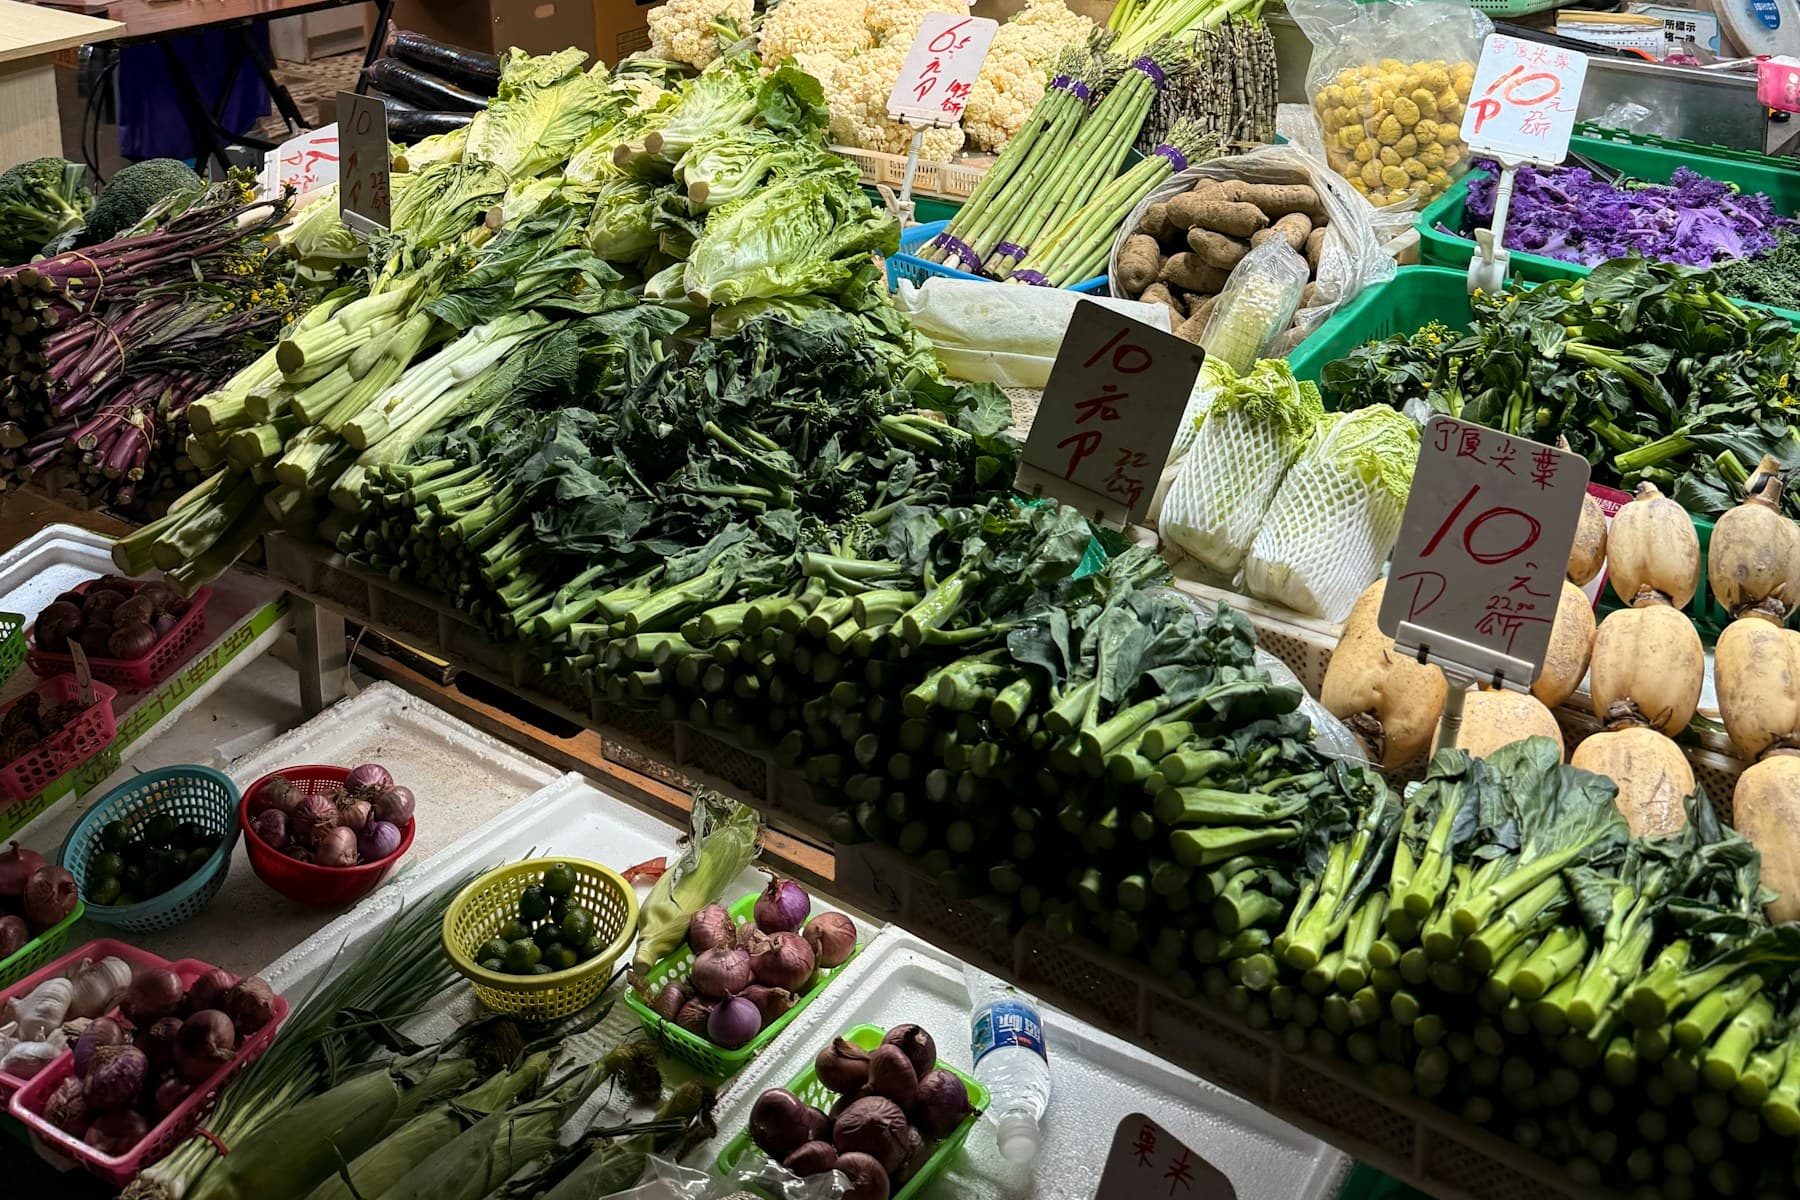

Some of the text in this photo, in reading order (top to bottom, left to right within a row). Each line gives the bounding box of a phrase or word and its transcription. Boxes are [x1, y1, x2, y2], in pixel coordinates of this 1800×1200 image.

[1664, 20, 1696, 33] 所標示
[1486, 64, 1561, 106] 10
[346, 99, 372, 136] 10
[1469, 98, 1502, 134] P
[1083, 327, 1153, 374] 10
[1056, 430, 1102, 481] P
[1419, 483, 1542, 565] 10
